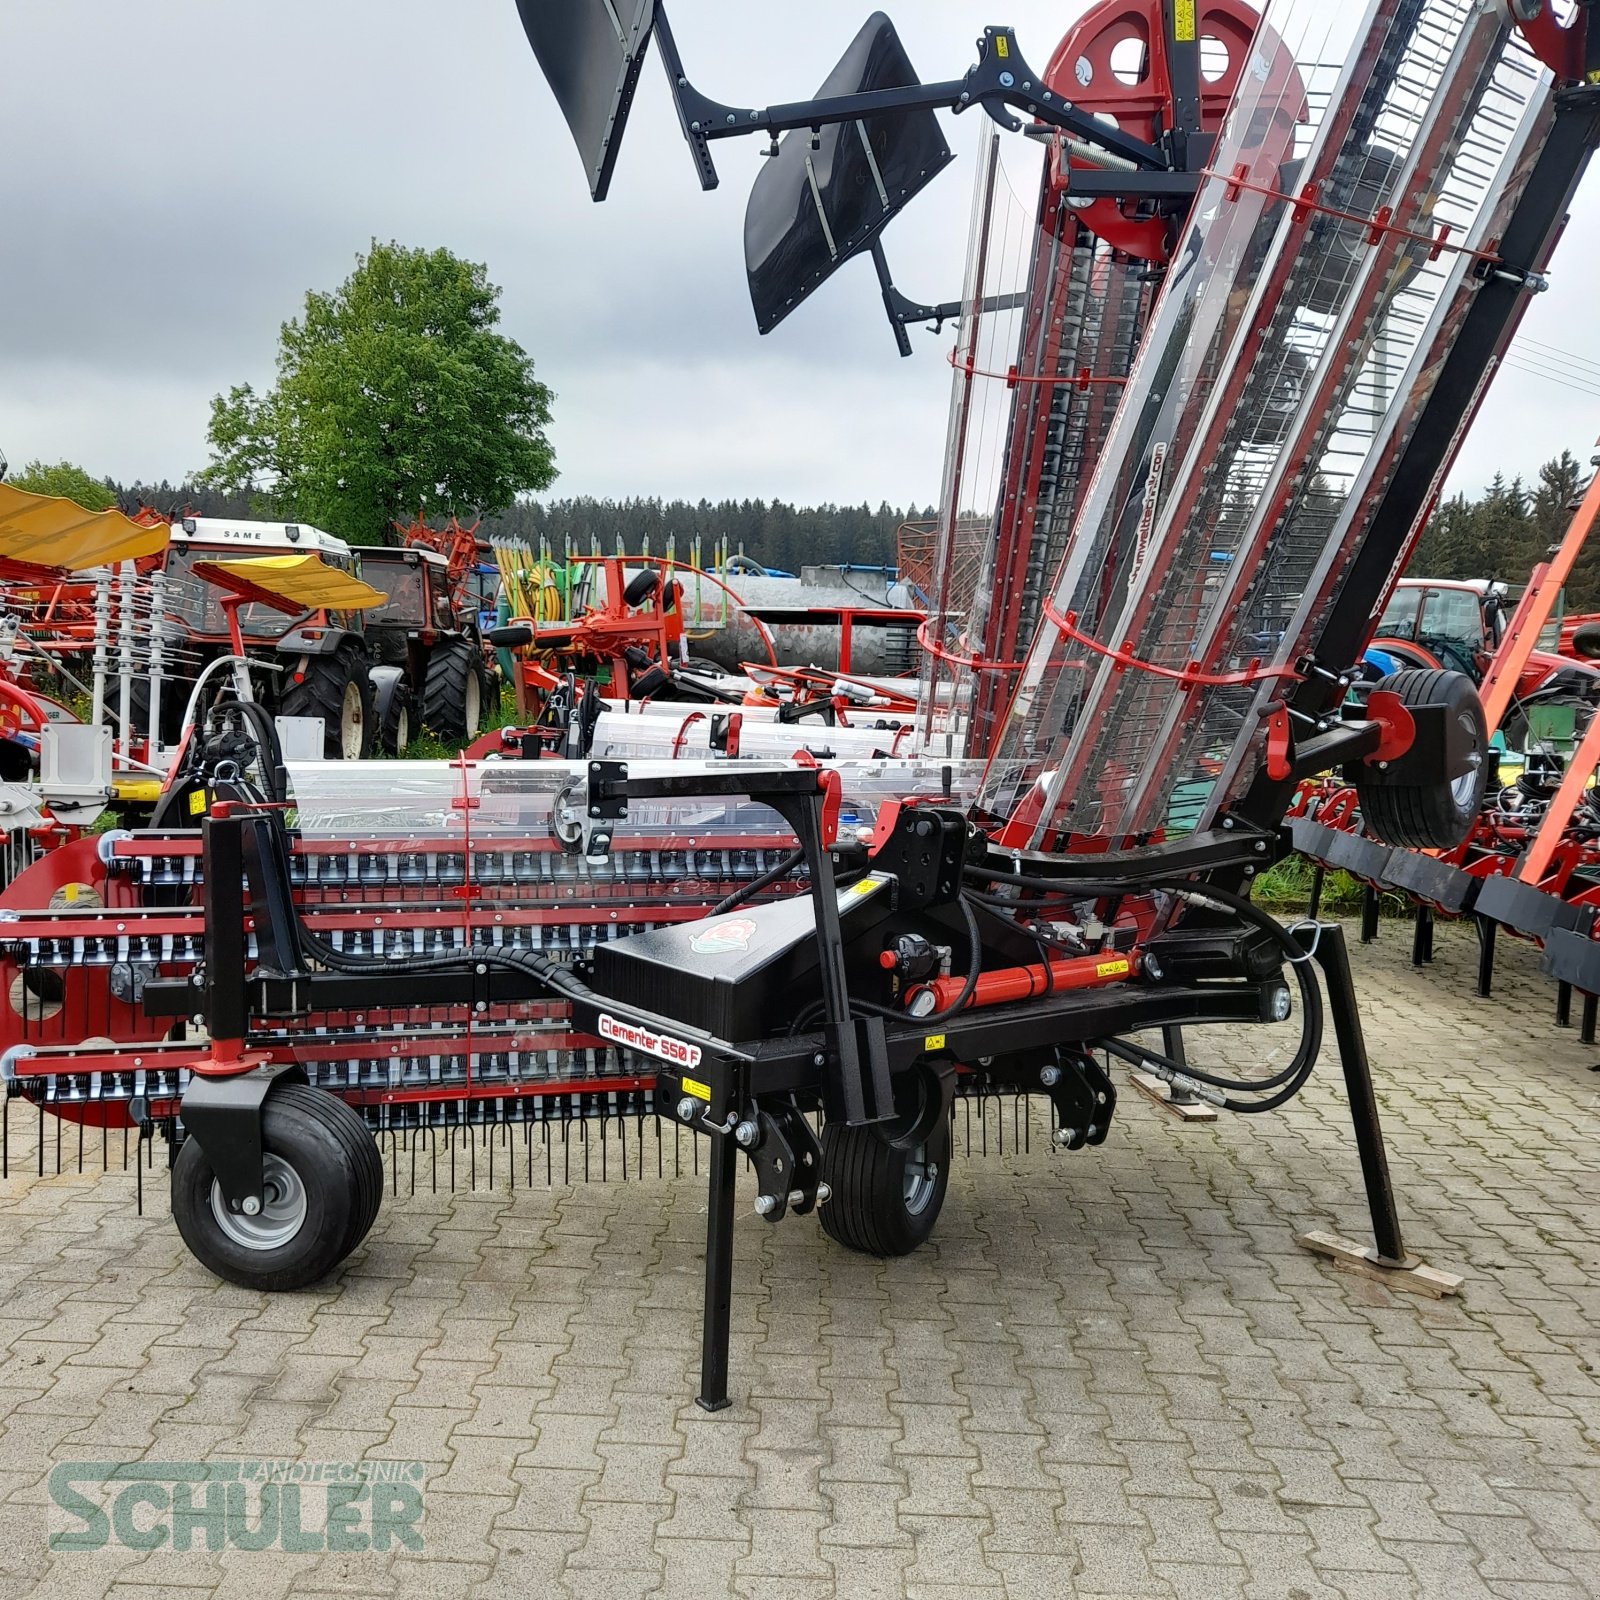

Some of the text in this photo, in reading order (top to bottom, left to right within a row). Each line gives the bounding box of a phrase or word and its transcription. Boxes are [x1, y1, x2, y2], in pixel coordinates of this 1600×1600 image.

[223, 530, 262, 540] SAME
[601, 1017, 699, 1064] Clementer 550 F
